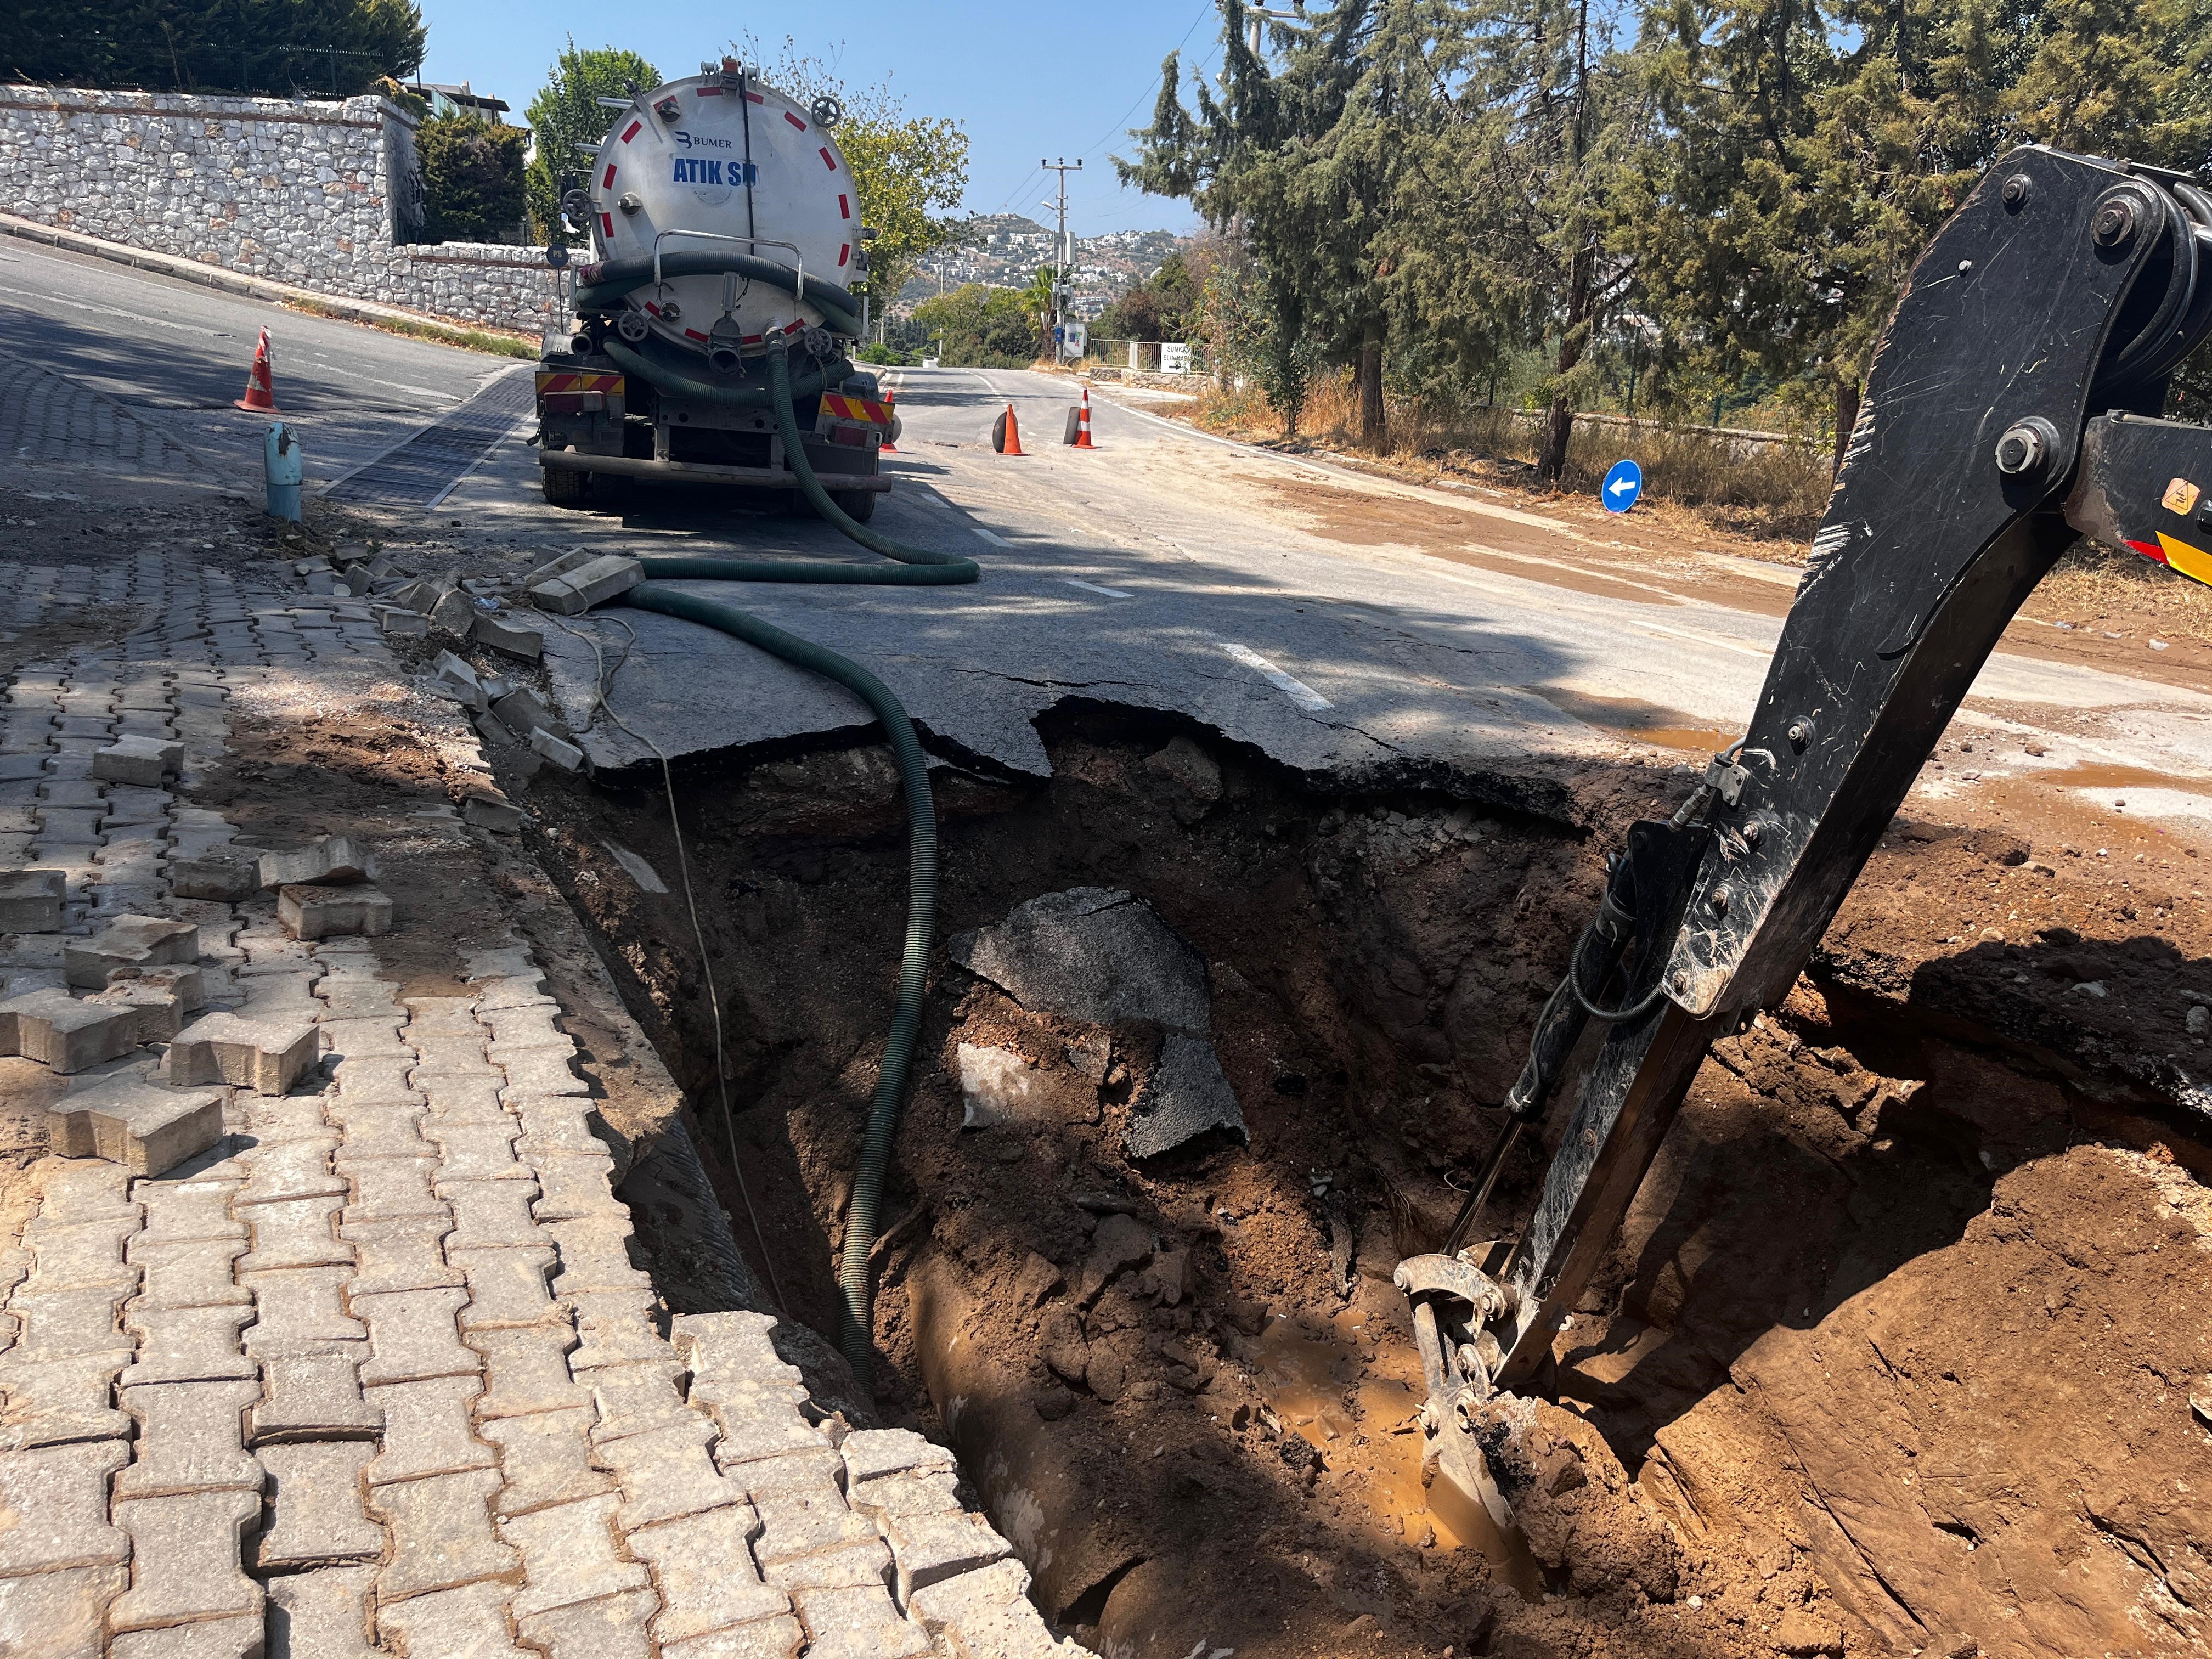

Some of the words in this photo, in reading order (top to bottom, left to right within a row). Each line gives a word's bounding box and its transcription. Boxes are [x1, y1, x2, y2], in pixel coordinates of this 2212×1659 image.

[694, 137, 732, 149] BUMER
[673, 158, 723, 185] ATIK
[727, 162, 756, 188] SU
[553, 250, 562, 258] PS
